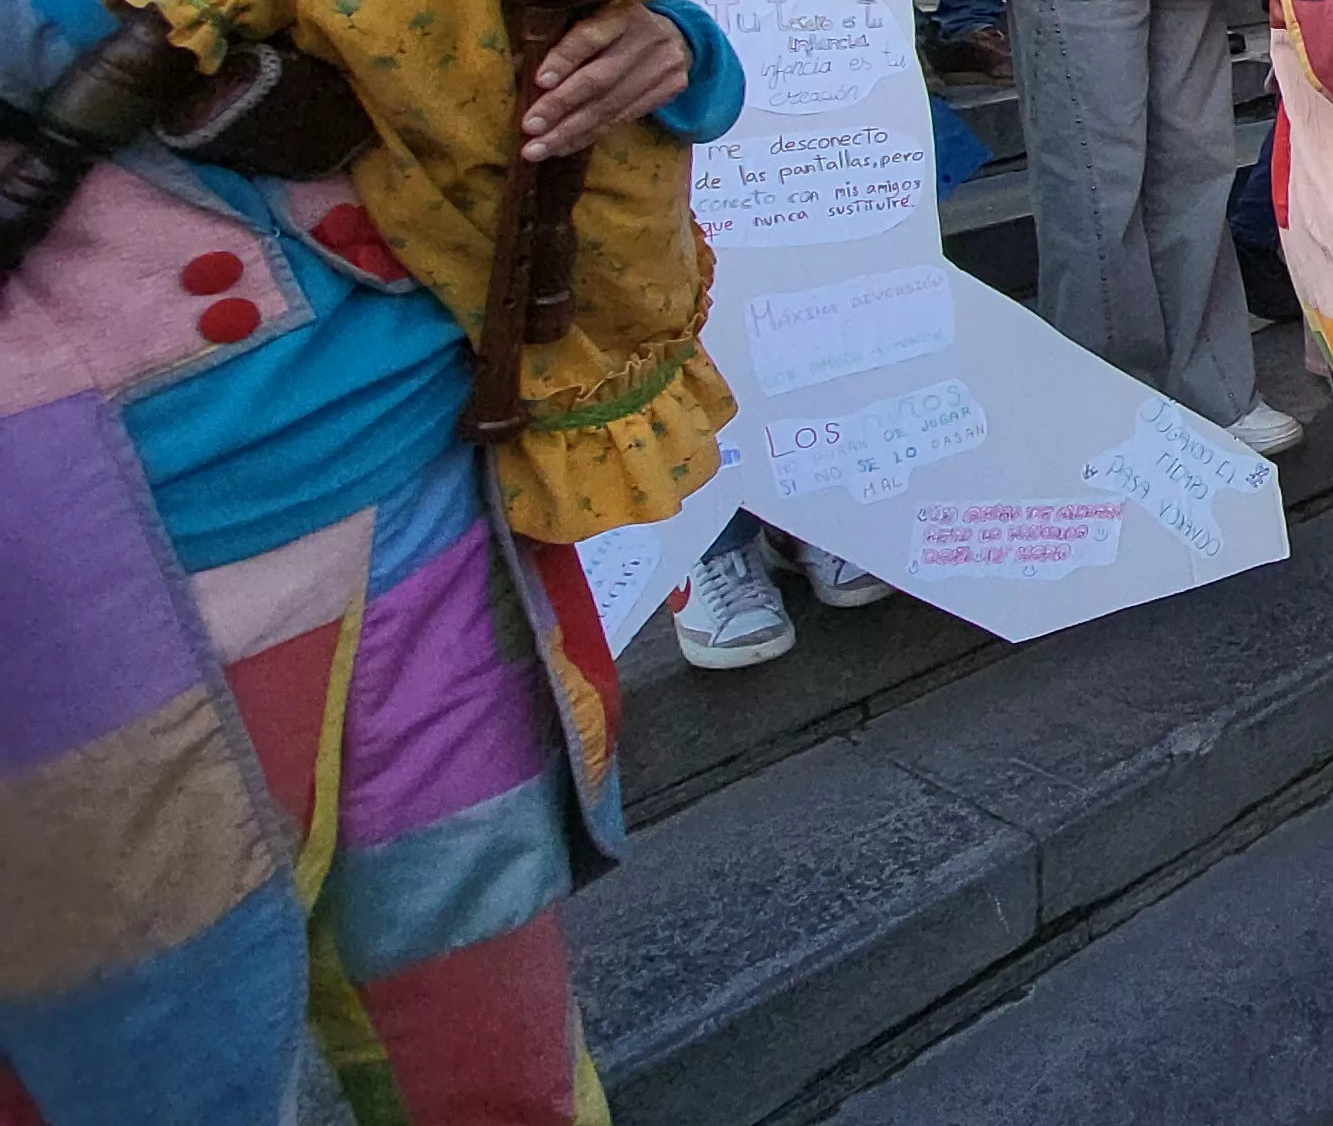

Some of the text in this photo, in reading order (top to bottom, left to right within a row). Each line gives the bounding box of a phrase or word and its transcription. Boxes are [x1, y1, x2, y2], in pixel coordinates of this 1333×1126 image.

[708, 127, 888, 161] me desconecto
[695, 172, 722, 190] de
[738, 165, 766, 186] las
[879, 151, 924, 170] pero
[834, 181, 859, 200] mis
[866, 179, 922, 198] amigos
[700, 219, 733, 243] que
[754, 210, 809, 227] nunca
[921, 405, 972, 432] JUGAR
[765, 422, 840, 458] LOS
[814, 466, 842, 483] NO
[857, 457, 880, 473] SE
[863, 477, 904, 498] MAL
